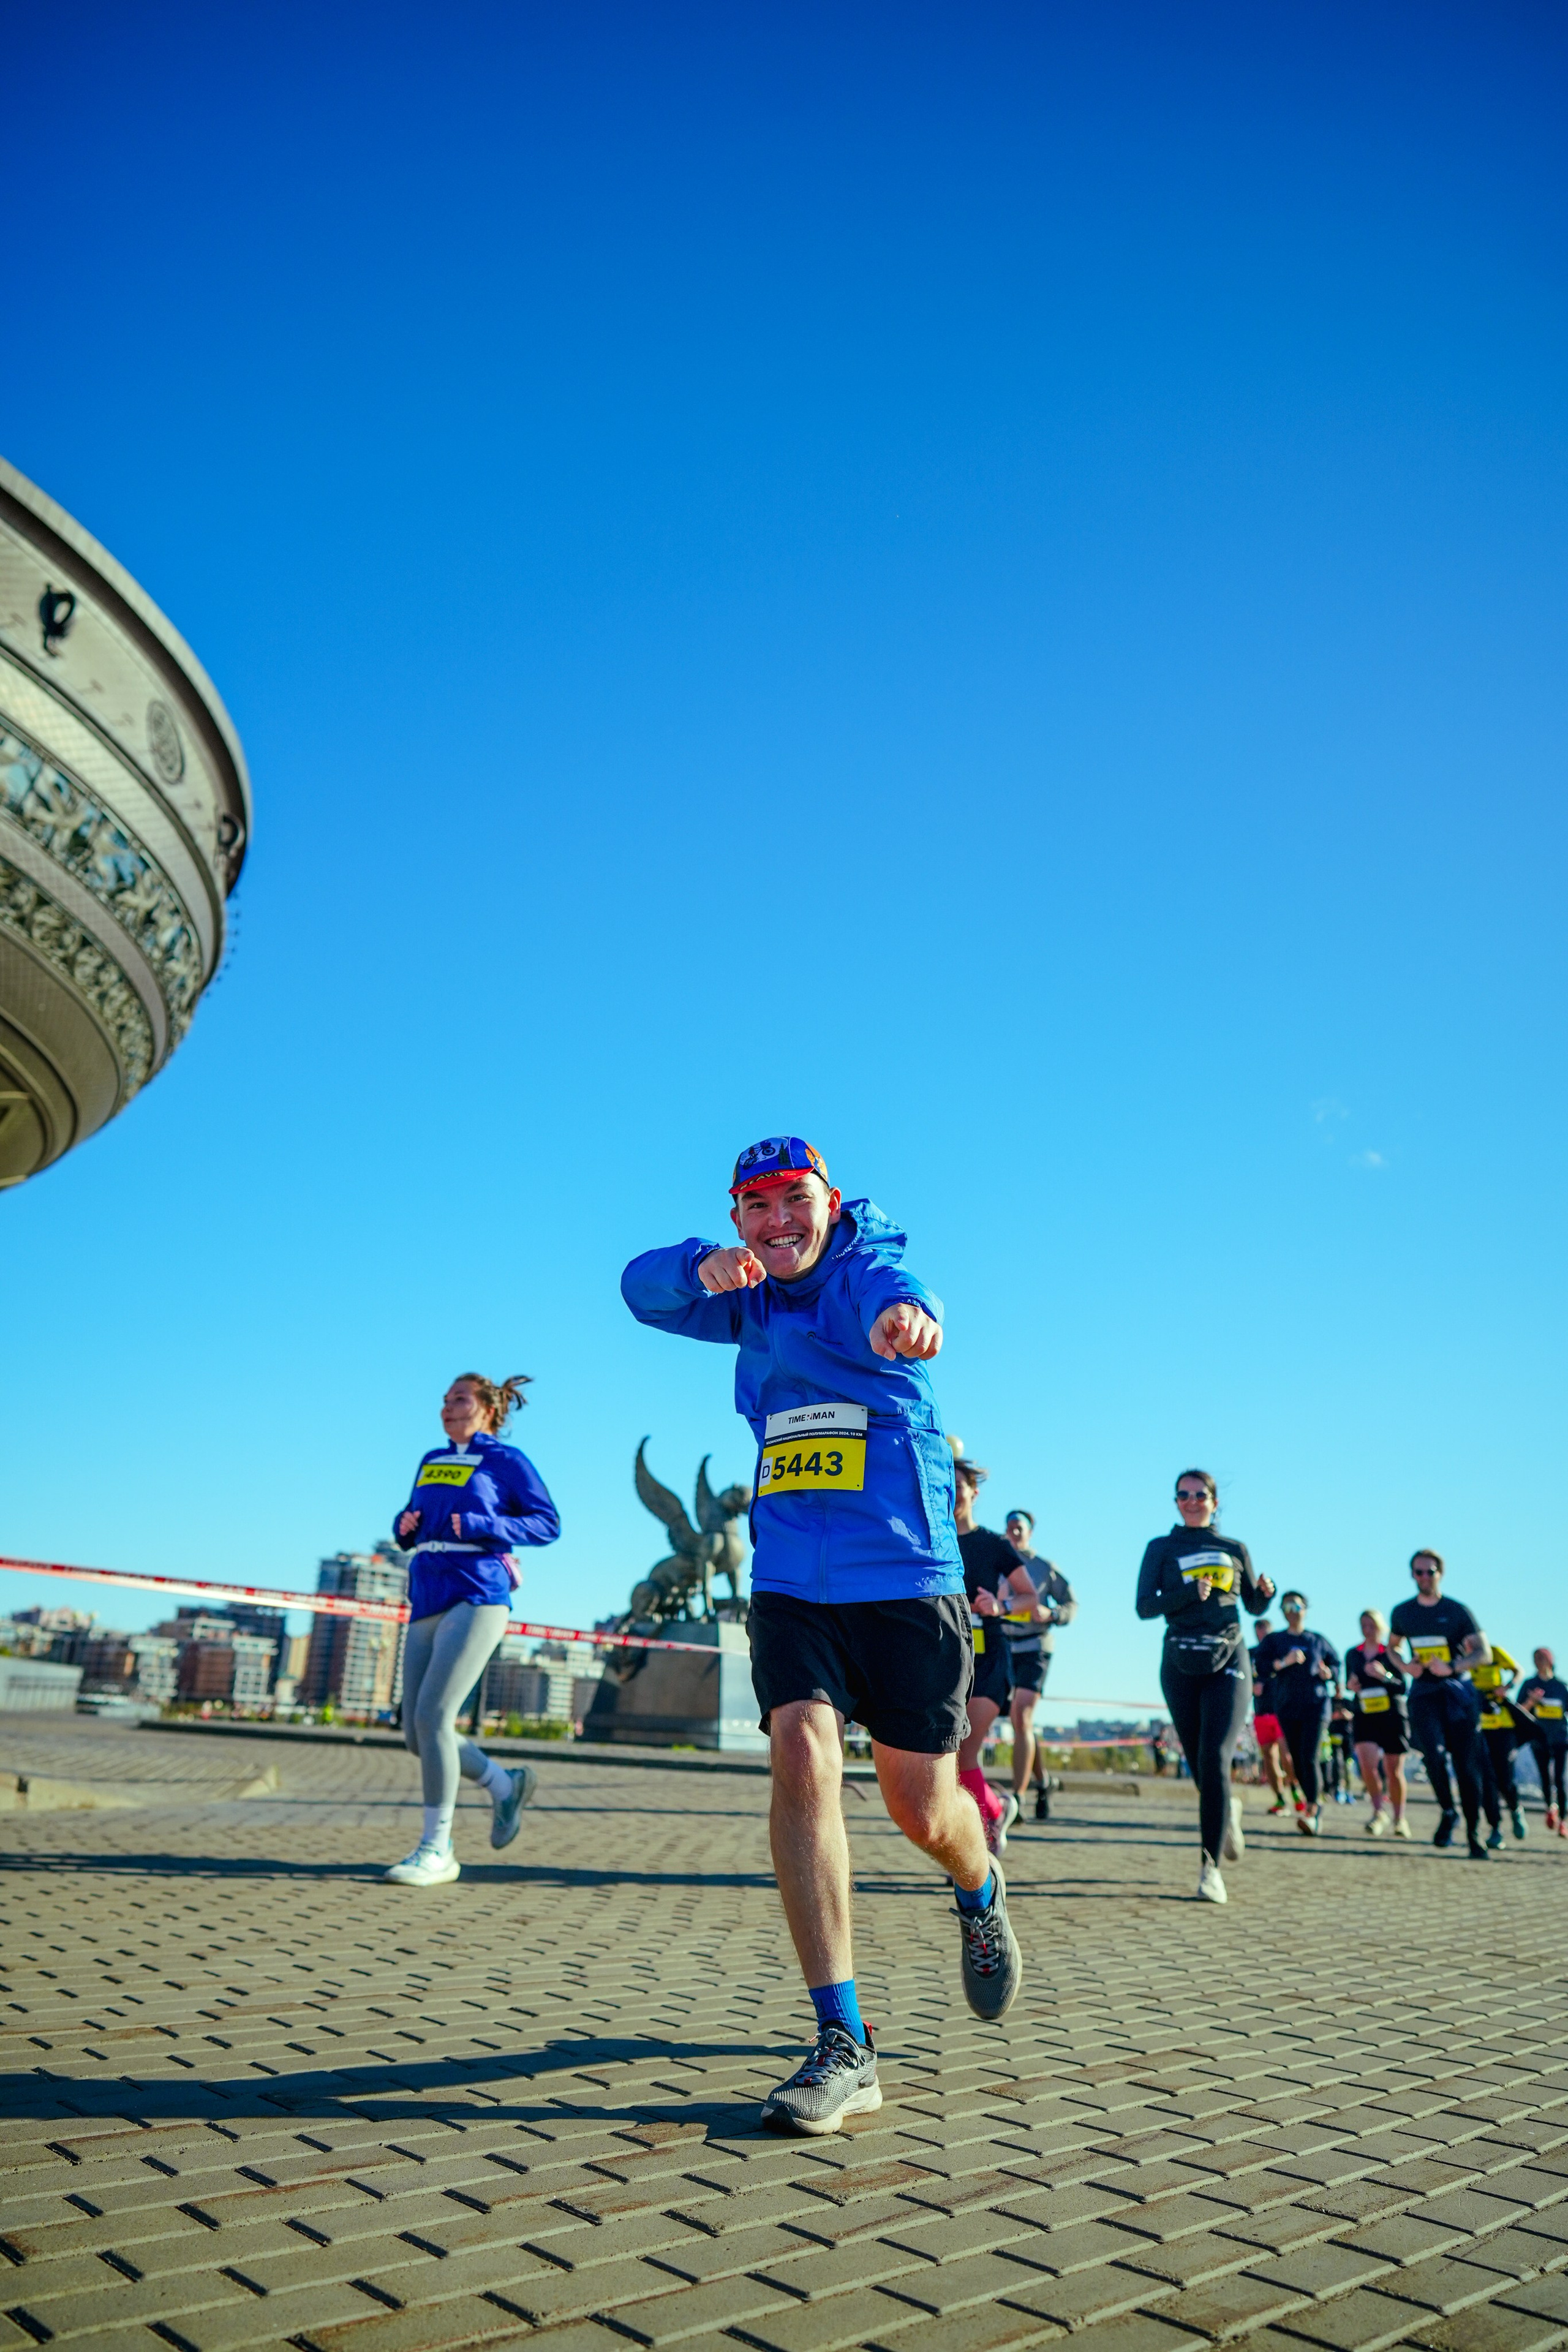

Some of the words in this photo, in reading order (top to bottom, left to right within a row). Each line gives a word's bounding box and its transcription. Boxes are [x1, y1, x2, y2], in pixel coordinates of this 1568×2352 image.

[783, 1432, 809, 1441] НАЦИОНАЛЬНЫЙ
[762, 1465, 770, 1479] D
[772, 1451, 843, 1480] 5443
